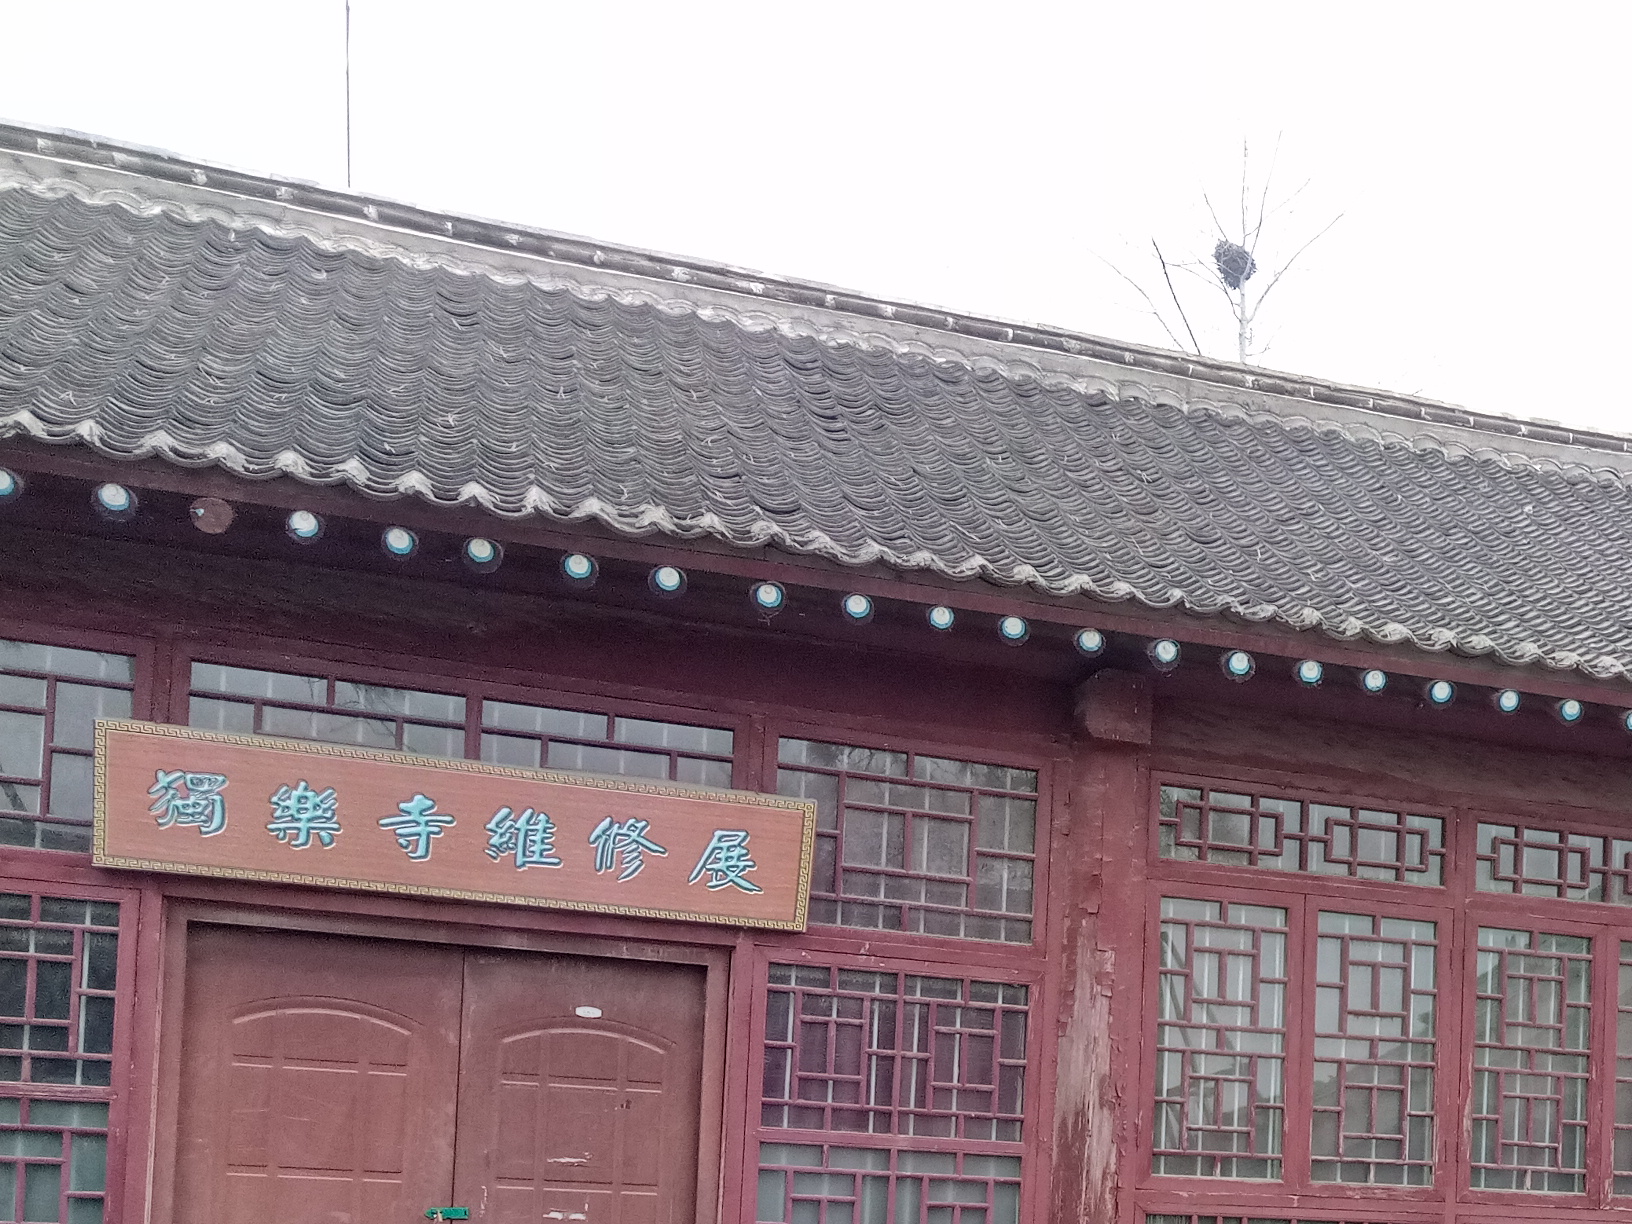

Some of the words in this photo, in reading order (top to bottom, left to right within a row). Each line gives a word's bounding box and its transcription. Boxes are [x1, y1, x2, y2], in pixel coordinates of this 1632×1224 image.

[146, 768, 764, 895] 獨樂寺維修展
